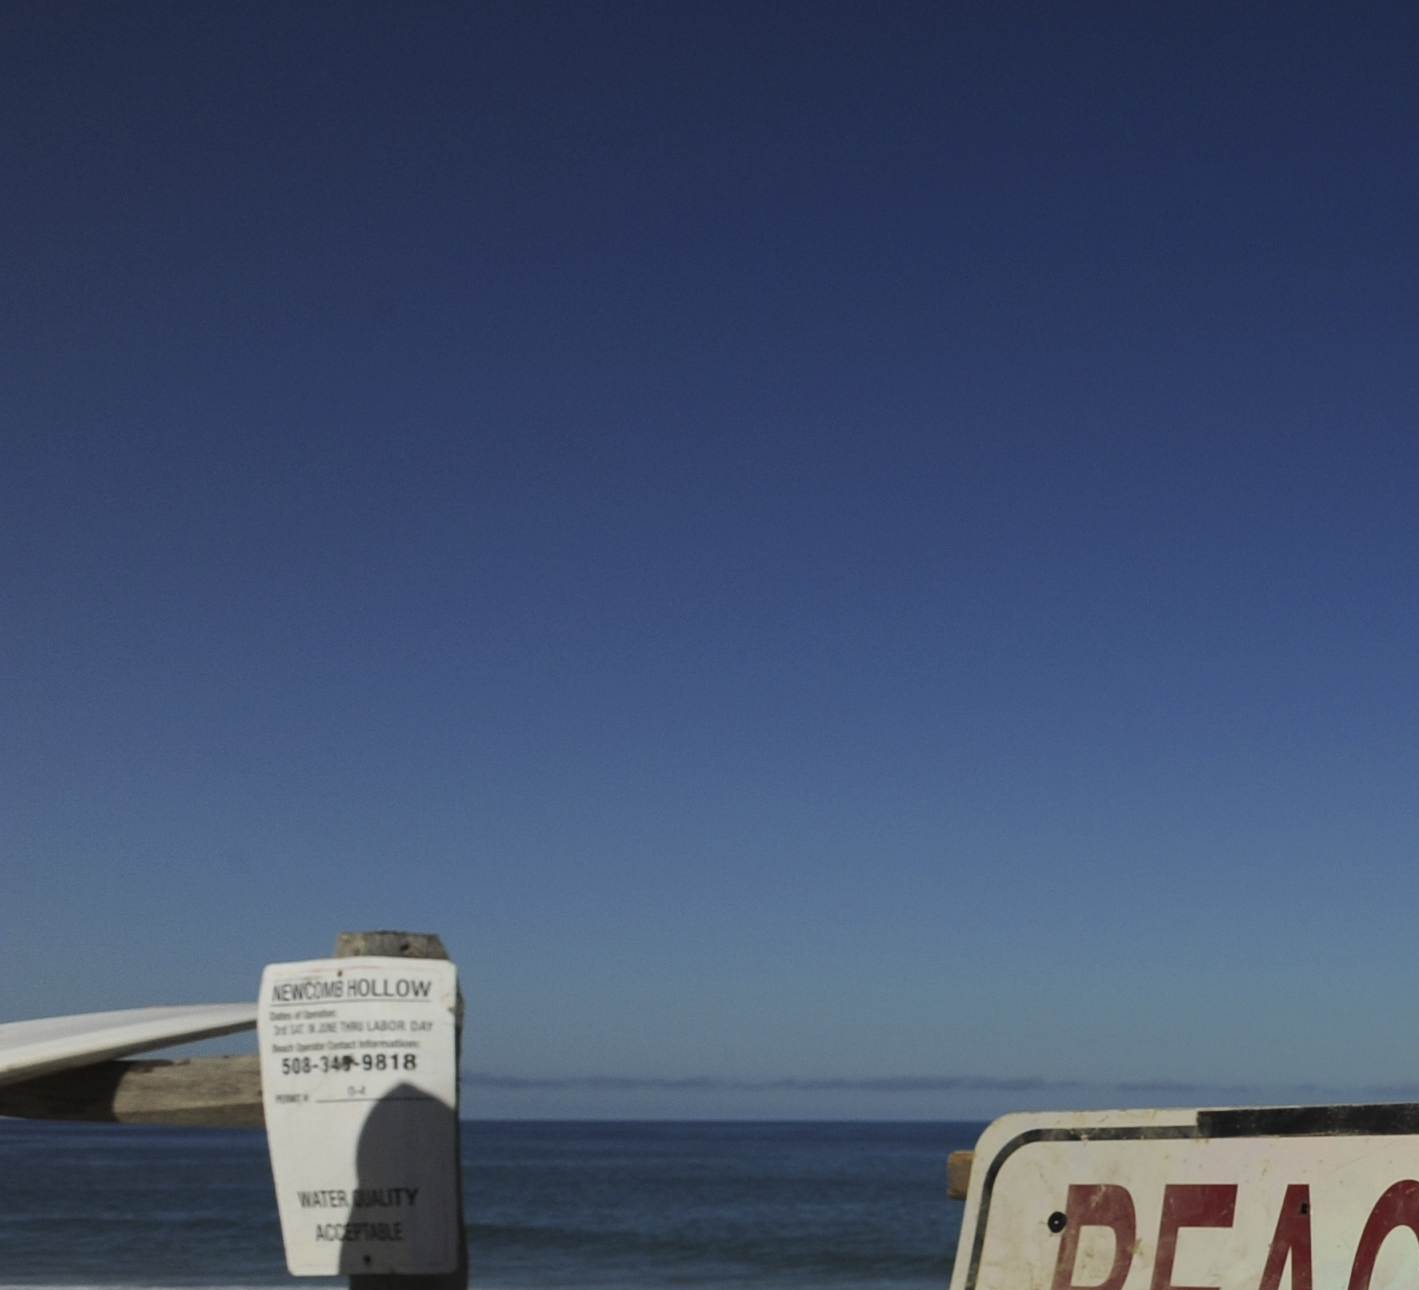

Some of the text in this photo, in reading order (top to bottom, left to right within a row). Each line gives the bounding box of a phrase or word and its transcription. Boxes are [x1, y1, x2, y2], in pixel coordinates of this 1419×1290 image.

[272, 978, 432, 1001] NEWCOMB HOLLOW
[367, 1020, 406, 1032] LABOR
[410, 1020, 433, 1032] DAY
[297, 1187, 419, 1208] WATER QUALITY
[315, 1222, 403, 1242] ACCEPTABLE
